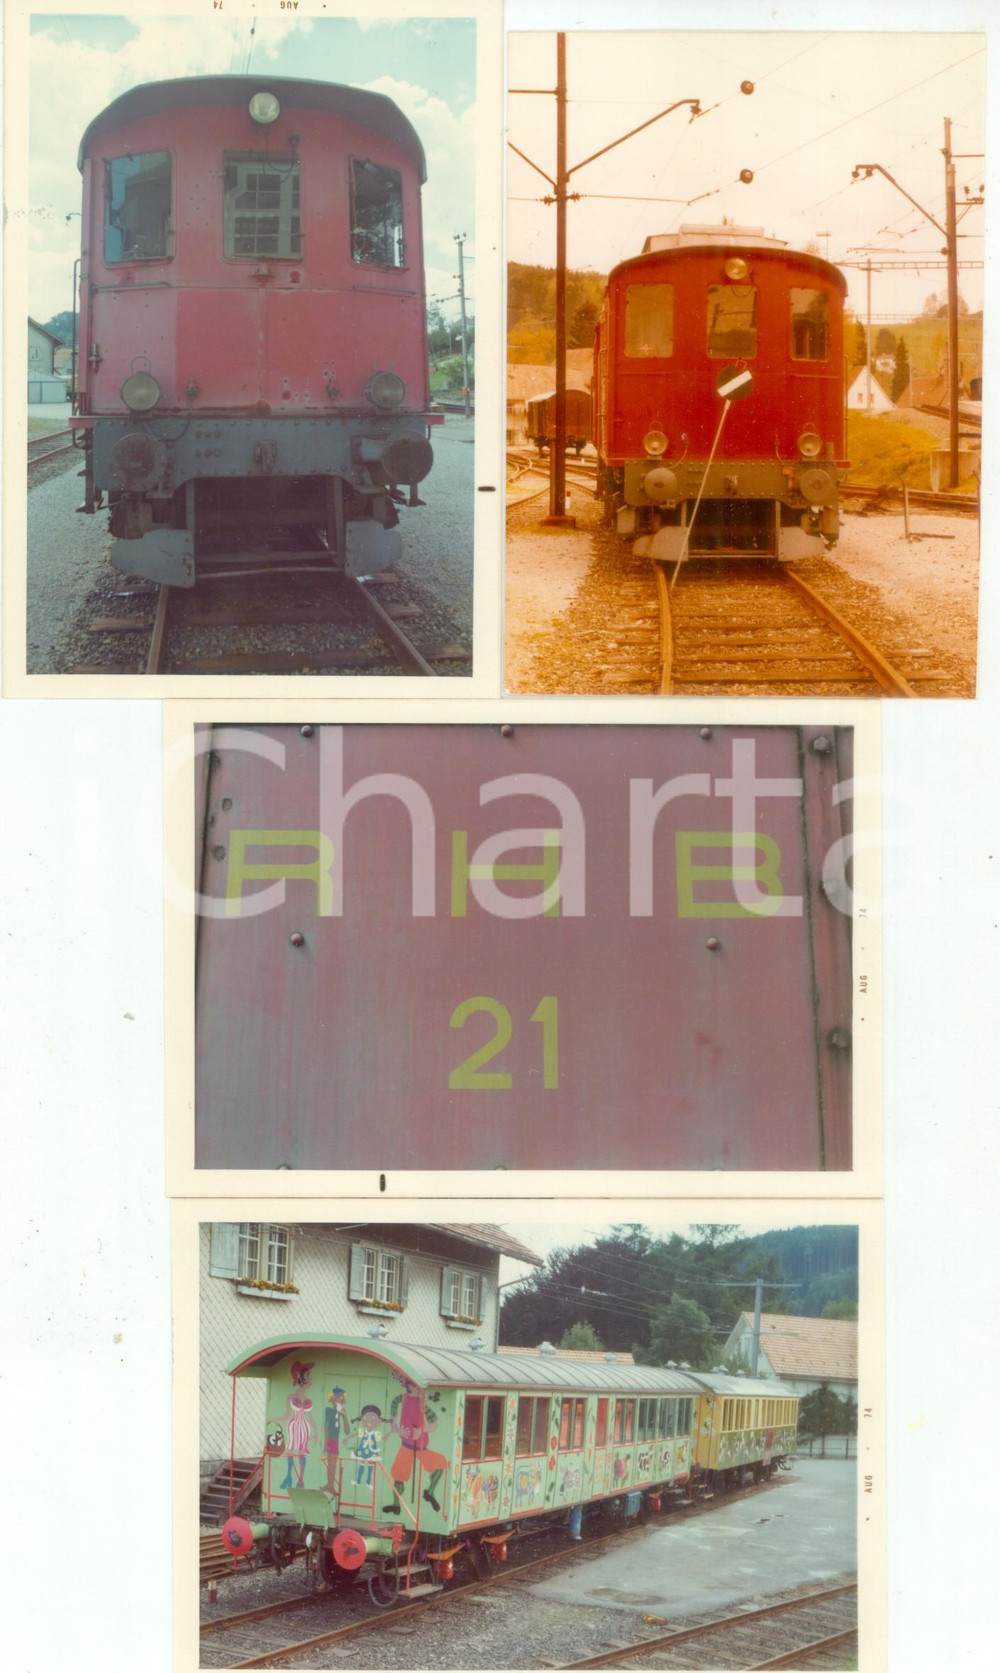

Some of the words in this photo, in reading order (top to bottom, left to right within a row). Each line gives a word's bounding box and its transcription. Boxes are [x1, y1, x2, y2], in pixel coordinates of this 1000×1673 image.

[213, 0, 223, 10] 74
[280, 0, 299, 10] AUG
[859, 908, 868, 919] 74
[859, 975, 868, 994] AUG
[449, 996, 559, 1090] 21
[864, 1408, 873, 1418] 74
[864, 1475, 873, 1494] AUG
